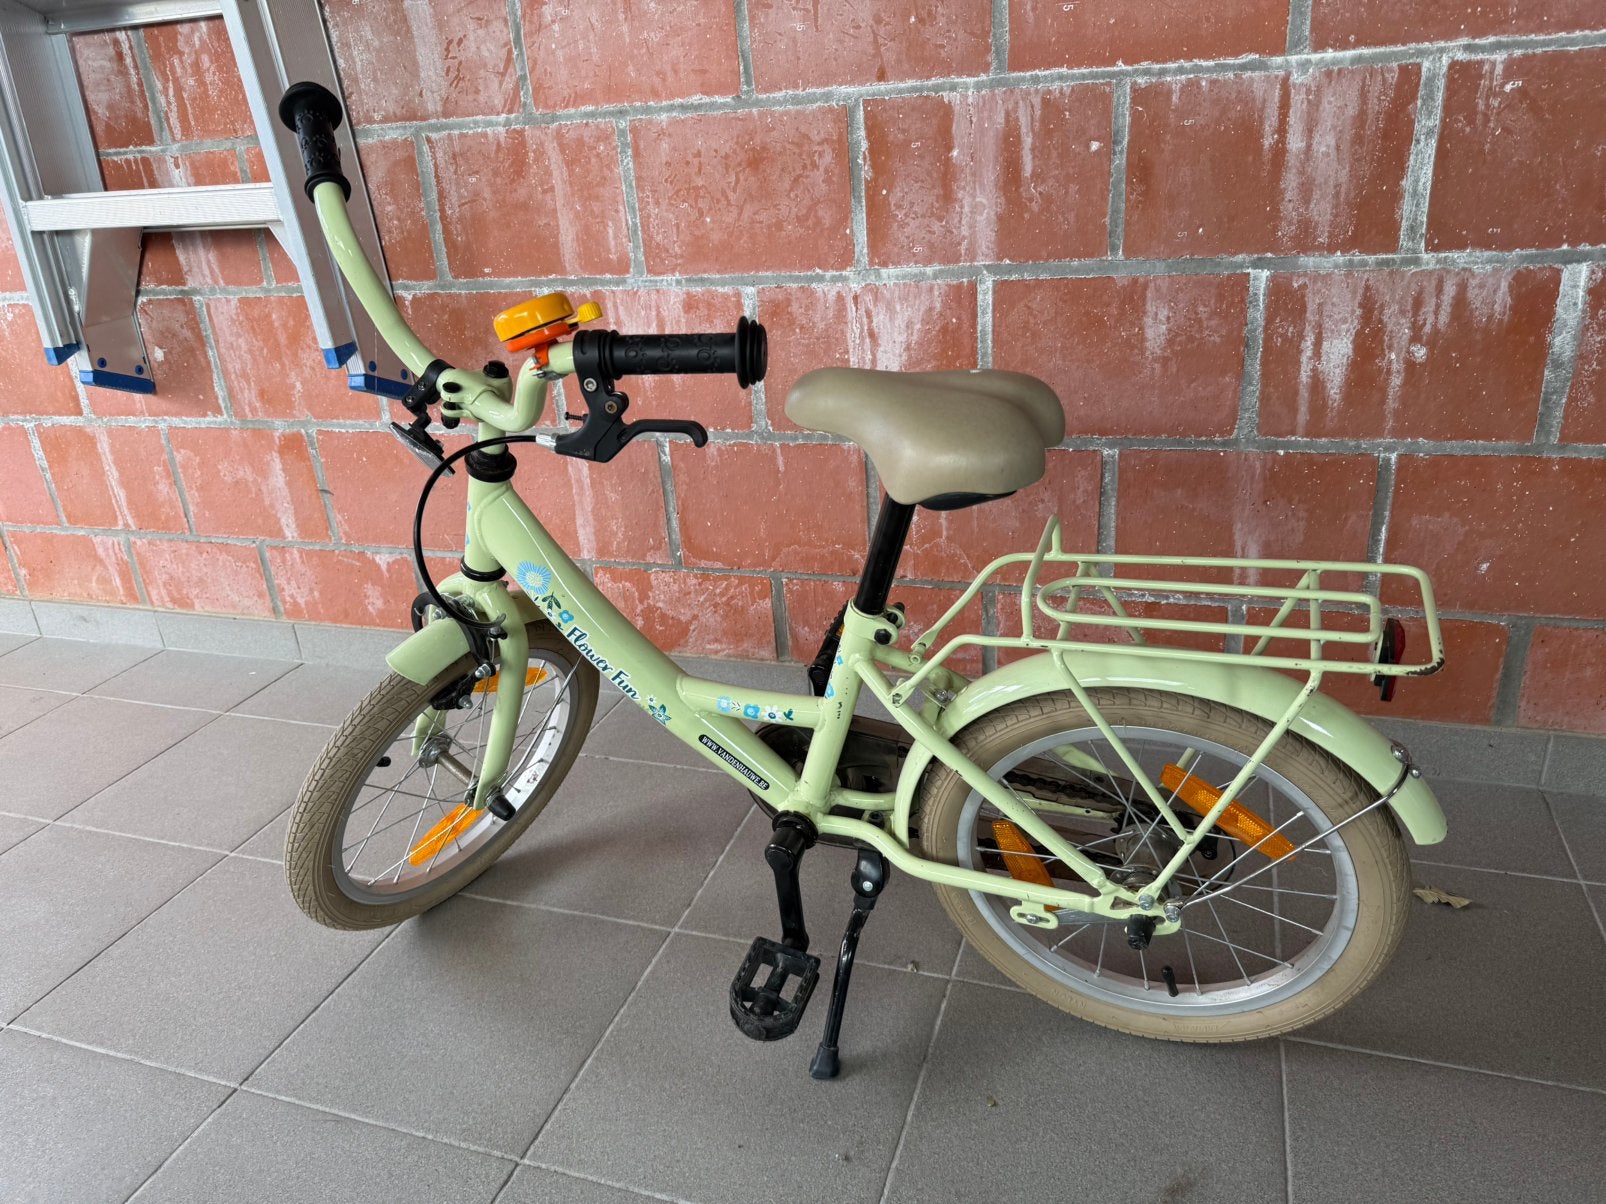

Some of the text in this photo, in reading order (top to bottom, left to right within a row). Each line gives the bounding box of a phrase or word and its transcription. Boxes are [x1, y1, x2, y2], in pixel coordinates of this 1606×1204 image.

[566, 626, 640, 700] Flower Fun
[701, 736, 769, 790] WWW.VANDENHAUWE.BE
